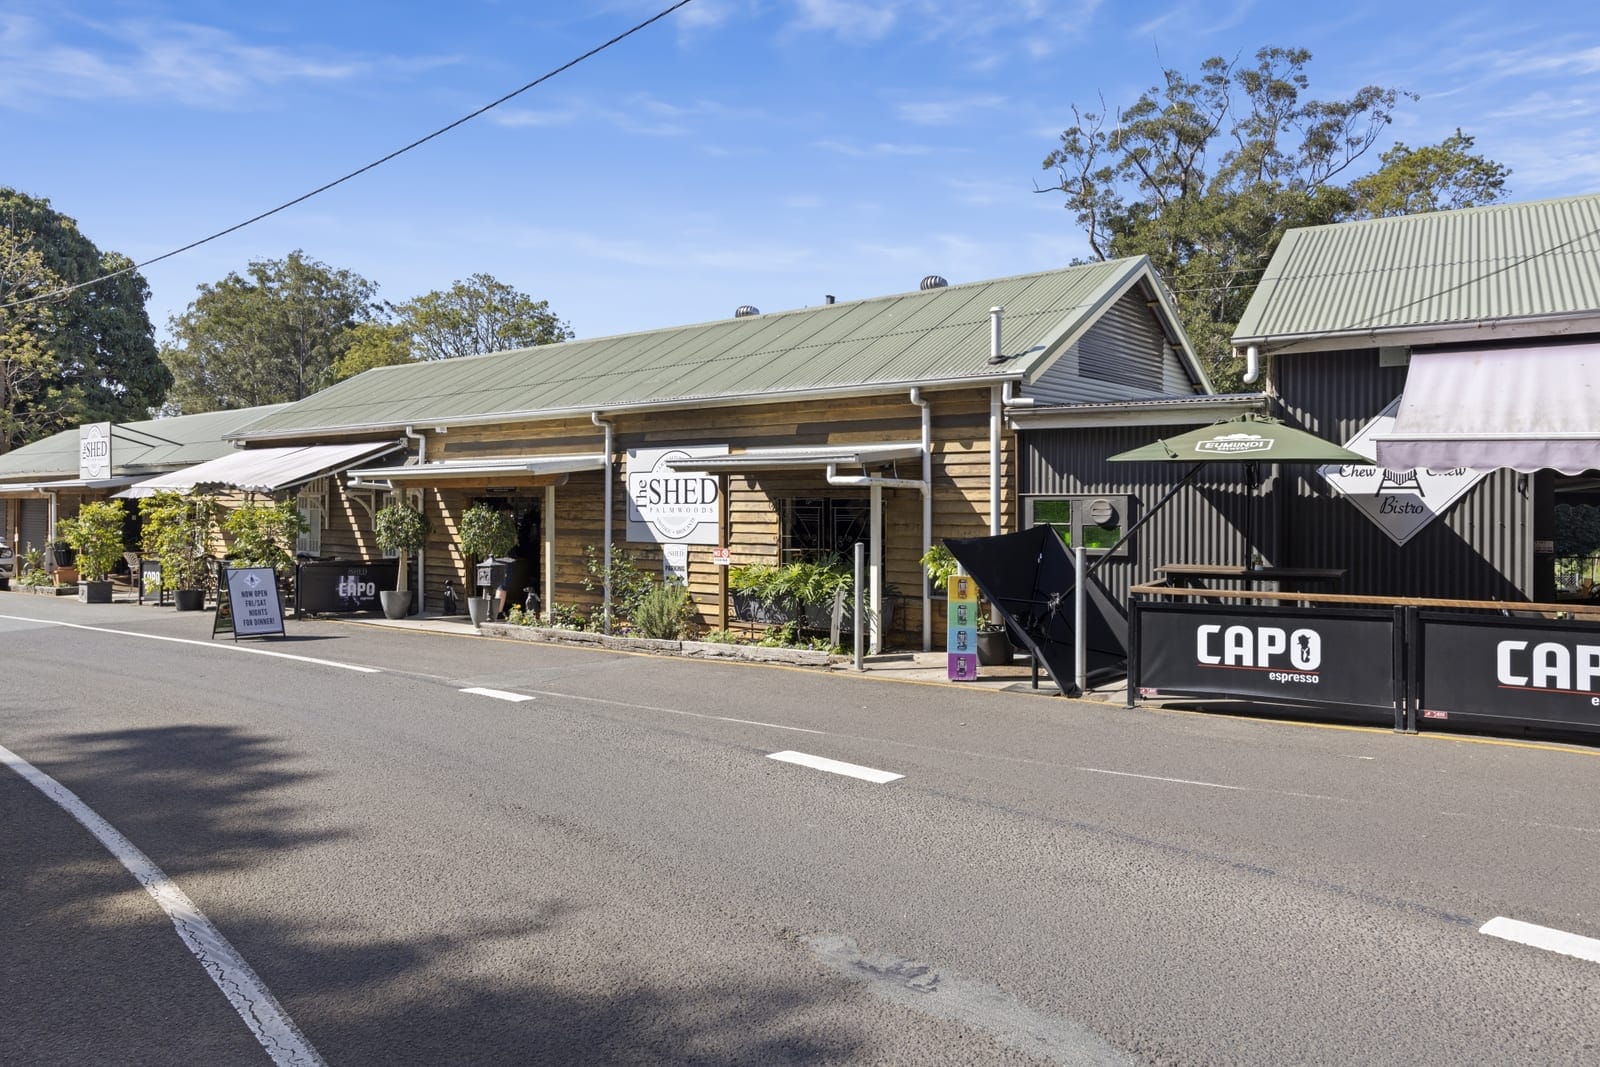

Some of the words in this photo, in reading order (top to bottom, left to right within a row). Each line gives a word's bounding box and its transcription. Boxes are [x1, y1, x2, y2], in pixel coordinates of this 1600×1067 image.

[86, 441, 108, 457] SHED
[1204, 441, 1264, 449] EUMUNDI
[1339, 463, 1377, 478] Chew
[635, 480, 648, 512] The
[649, 478, 719, 505] SHED
[1380, 496, 1424, 515] Bistro
[241, 590, 253, 598] NOW
[339, 582, 376, 597] CAPO
[1197, 624, 1321, 671] CAPO
[1269, 672, 1319, 683] espresso
